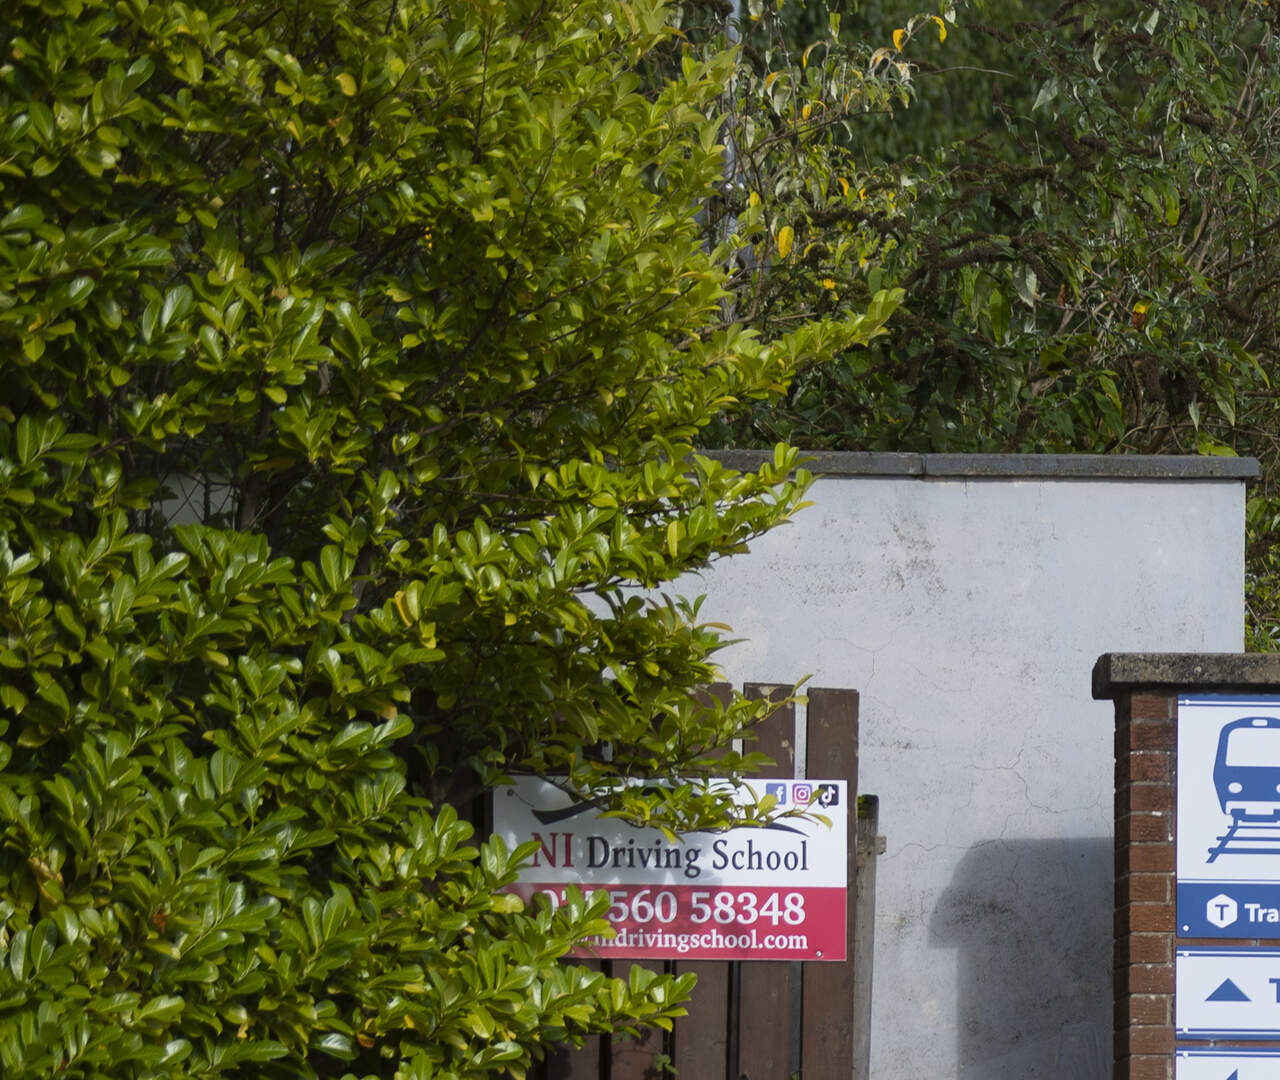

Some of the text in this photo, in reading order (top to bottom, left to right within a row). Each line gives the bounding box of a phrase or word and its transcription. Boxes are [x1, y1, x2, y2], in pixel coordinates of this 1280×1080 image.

[534, 831, 810, 880] NI Driving School
[690, 890, 806, 926] 58348
